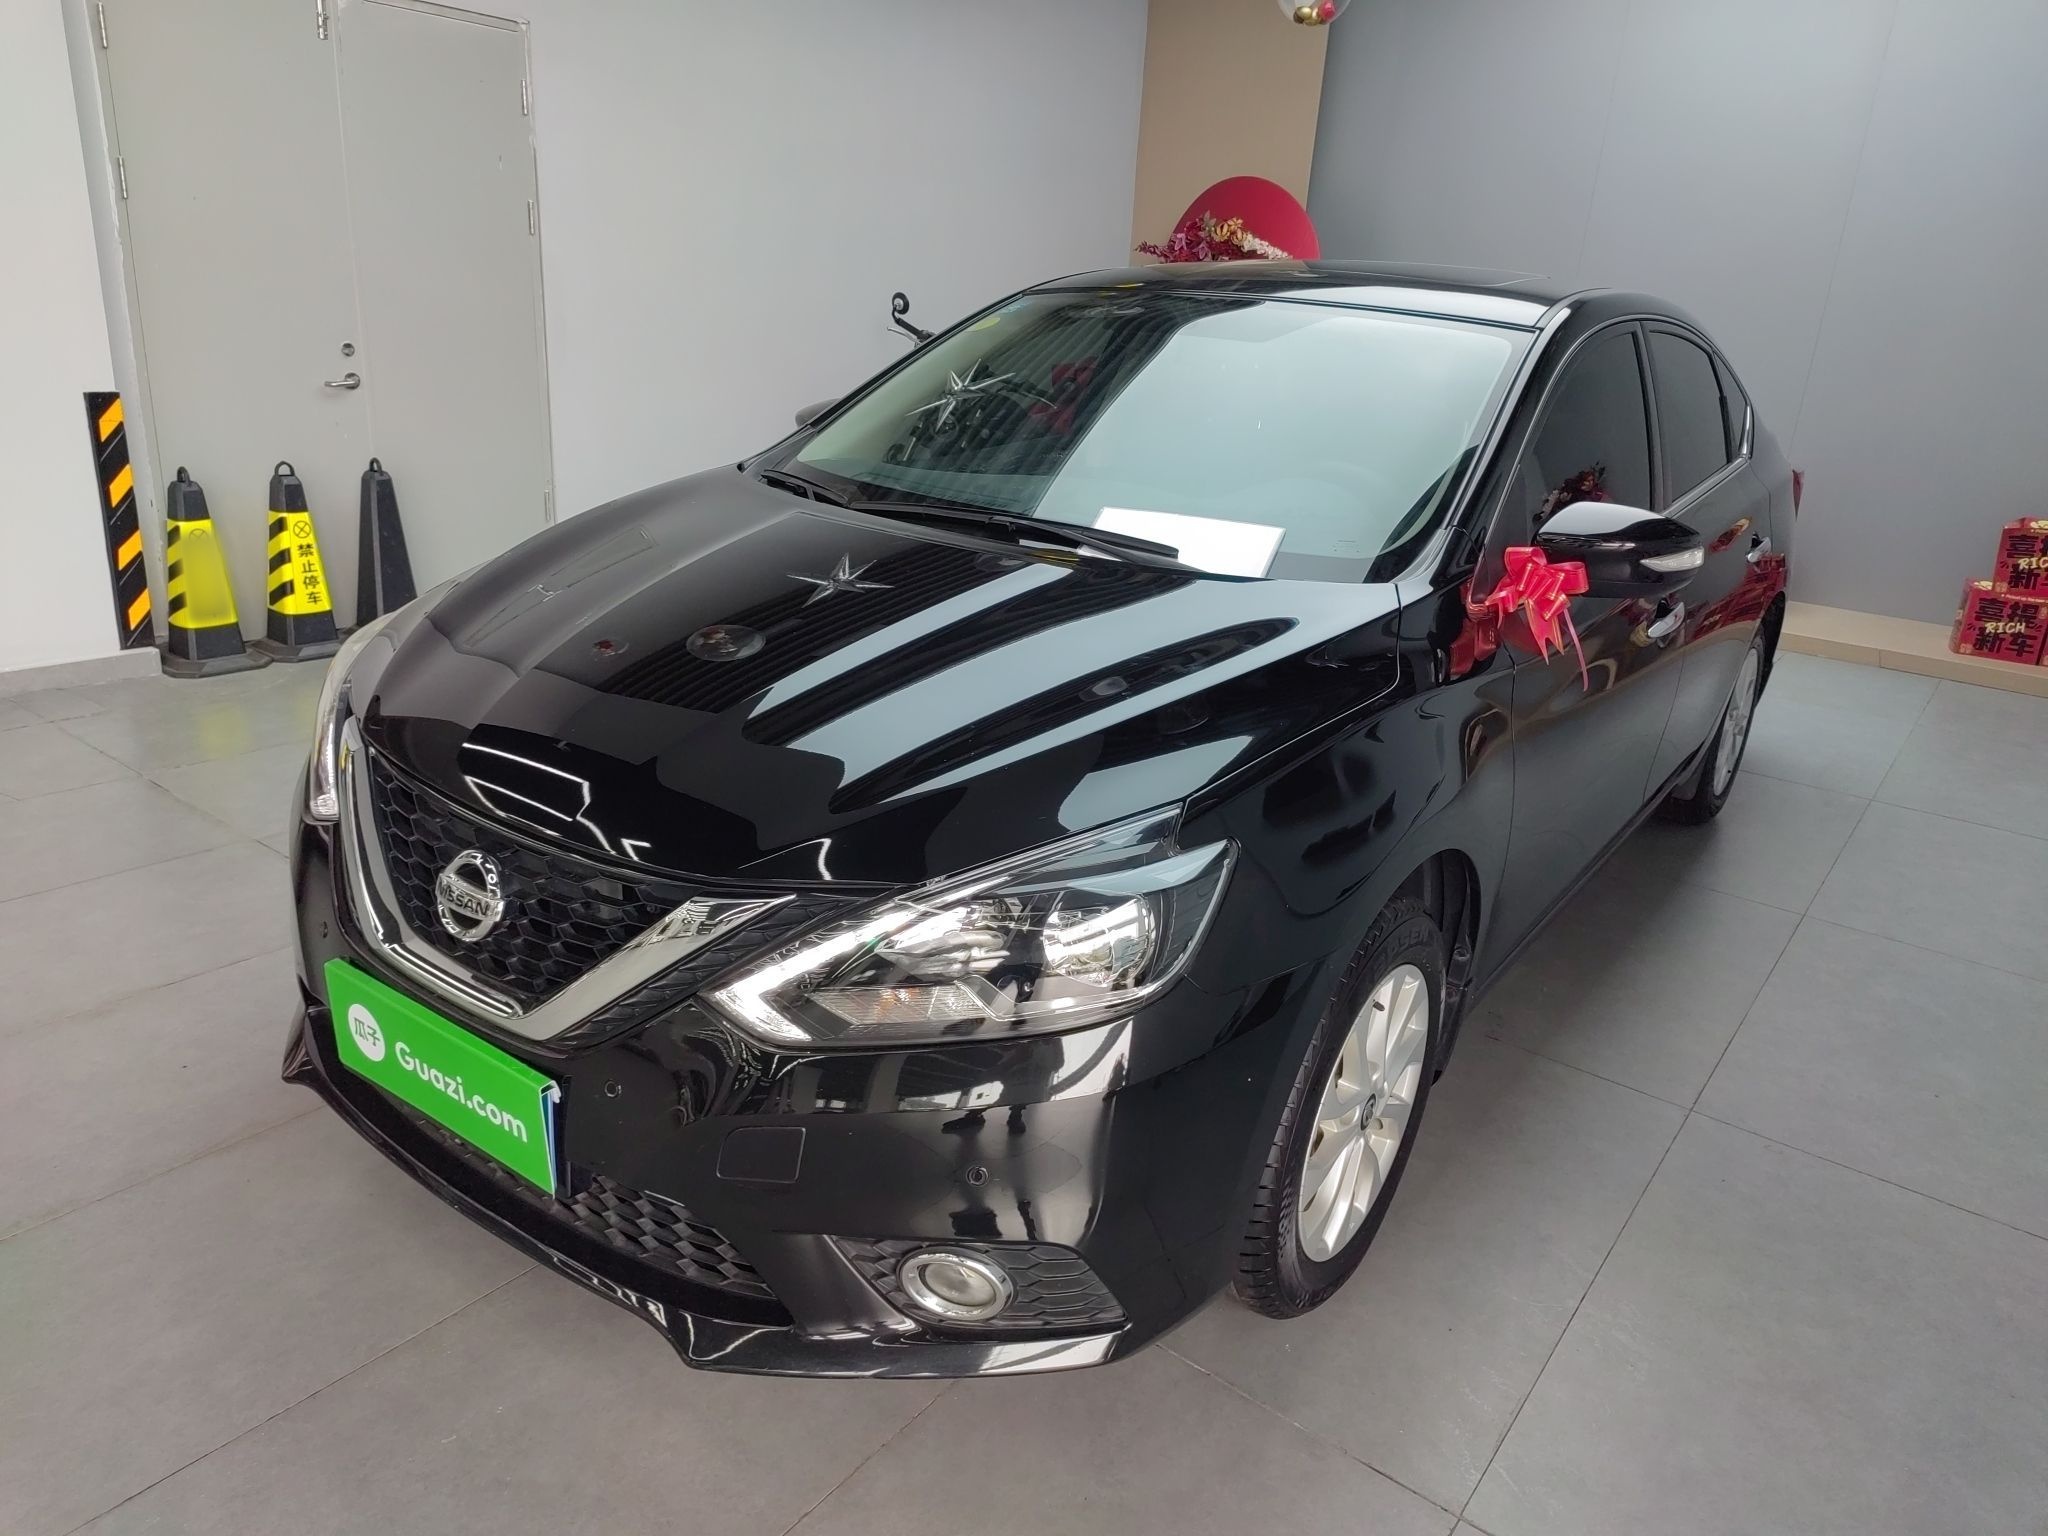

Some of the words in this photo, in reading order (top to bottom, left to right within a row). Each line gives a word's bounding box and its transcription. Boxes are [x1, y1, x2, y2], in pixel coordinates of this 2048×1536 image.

[2005, 535, 2048, 558] 喜
[297, 543, 322, 605] 禁止停车
[2007, 563, 2048, 590] 新
[1973, 628, 2038, 657] 新车
[1984, 622, 2026, 634] RICH
[353, 1016, 381, 1047] 瓜子
[394, 1041, 528, 1143] Guazi.com
